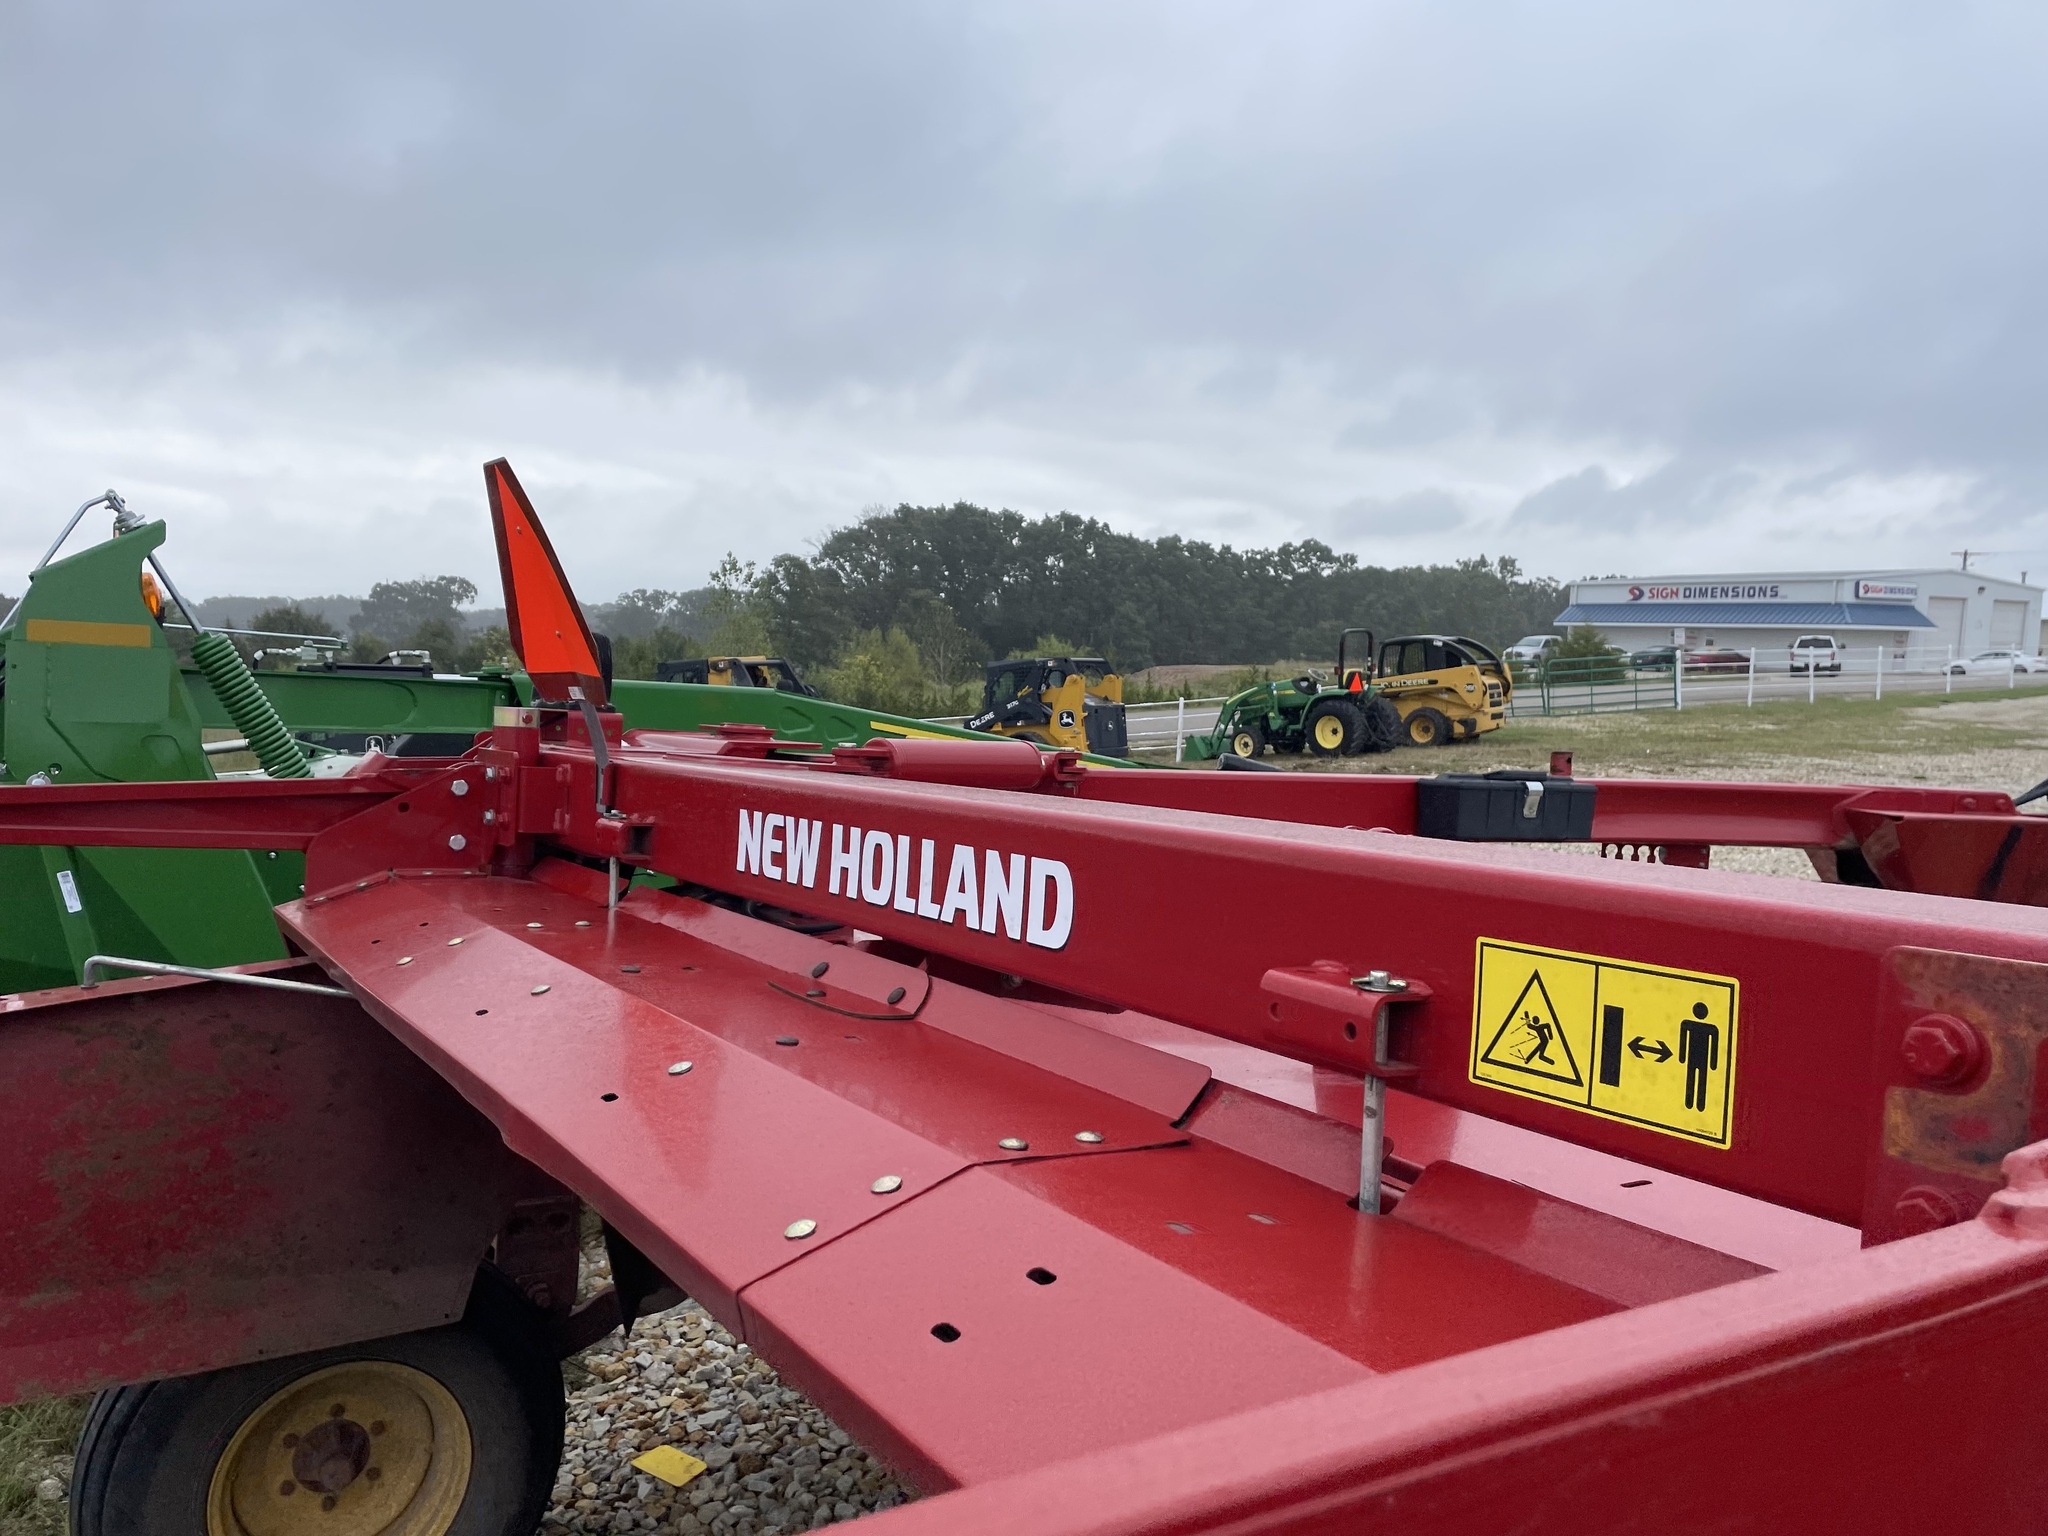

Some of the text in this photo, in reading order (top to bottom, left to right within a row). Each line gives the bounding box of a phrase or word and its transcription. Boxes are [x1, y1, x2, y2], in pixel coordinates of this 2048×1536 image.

[1648, 585, 1779, 599] SIGN DIMENSIONS
[1401, 679, 1429, 687] DEERE
[970, 711, 995, 729] DEERE
[736, 808, 1074, 949] NEW HOLLAND
